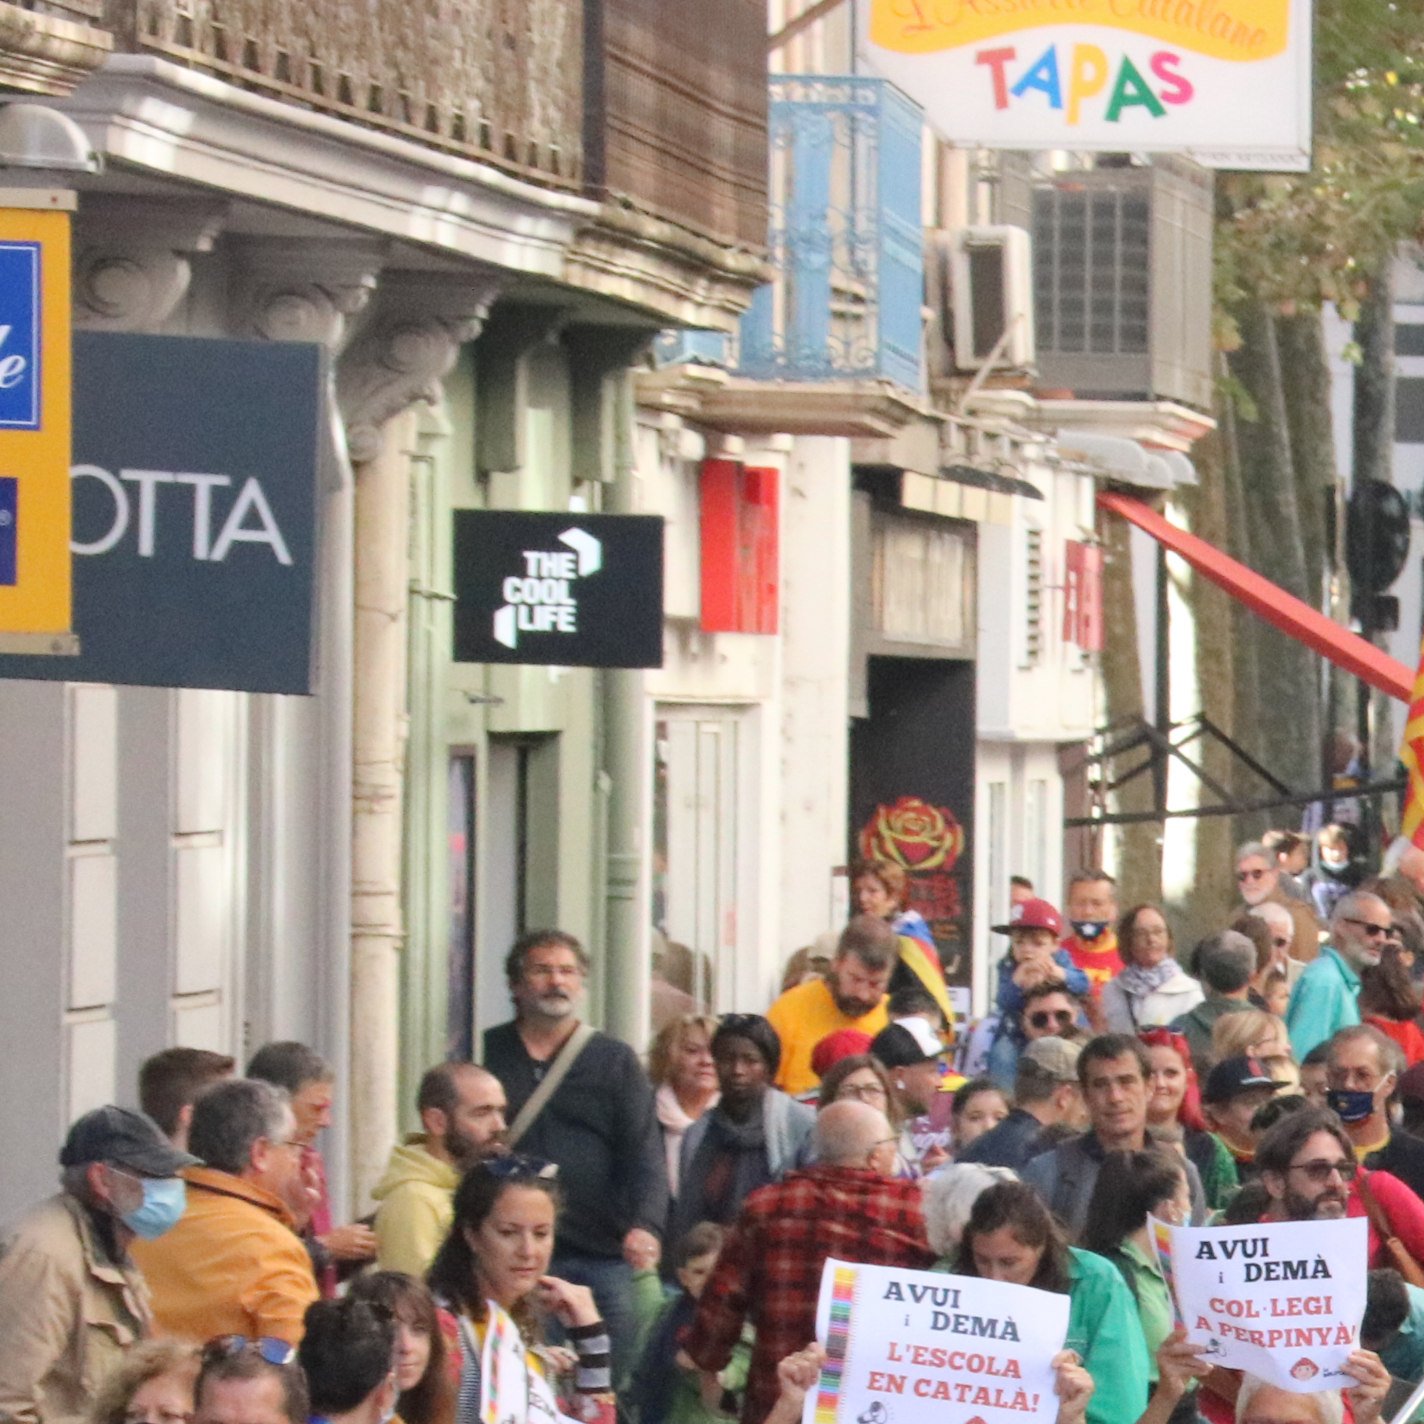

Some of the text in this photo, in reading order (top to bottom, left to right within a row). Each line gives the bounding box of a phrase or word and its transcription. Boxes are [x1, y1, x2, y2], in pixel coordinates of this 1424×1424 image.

[975, 42, 1195, 127] TAPAS
[523, 549, 577, 579] THE
[503, 577, 577, 606] COOL
[517, 604, 577, 633] LIFE
[1195, 1237, 1270, 1260] AVUI
[1218, 1254, 1333, 1284] i DEMÀ
[882, 1281, 962, 1309] AVUI
[1208, 1295, 1334, 1319] COL·LEGI
[903, 1310, 1022, 1343] i DEMÀ
[1194, 1315, 1358, 1348] A PERPINYÀ!
[886, 1341, 1023, 1380] L'ESCOLA
[866, 1370, 1041, 1413] EN CATALÀ!
